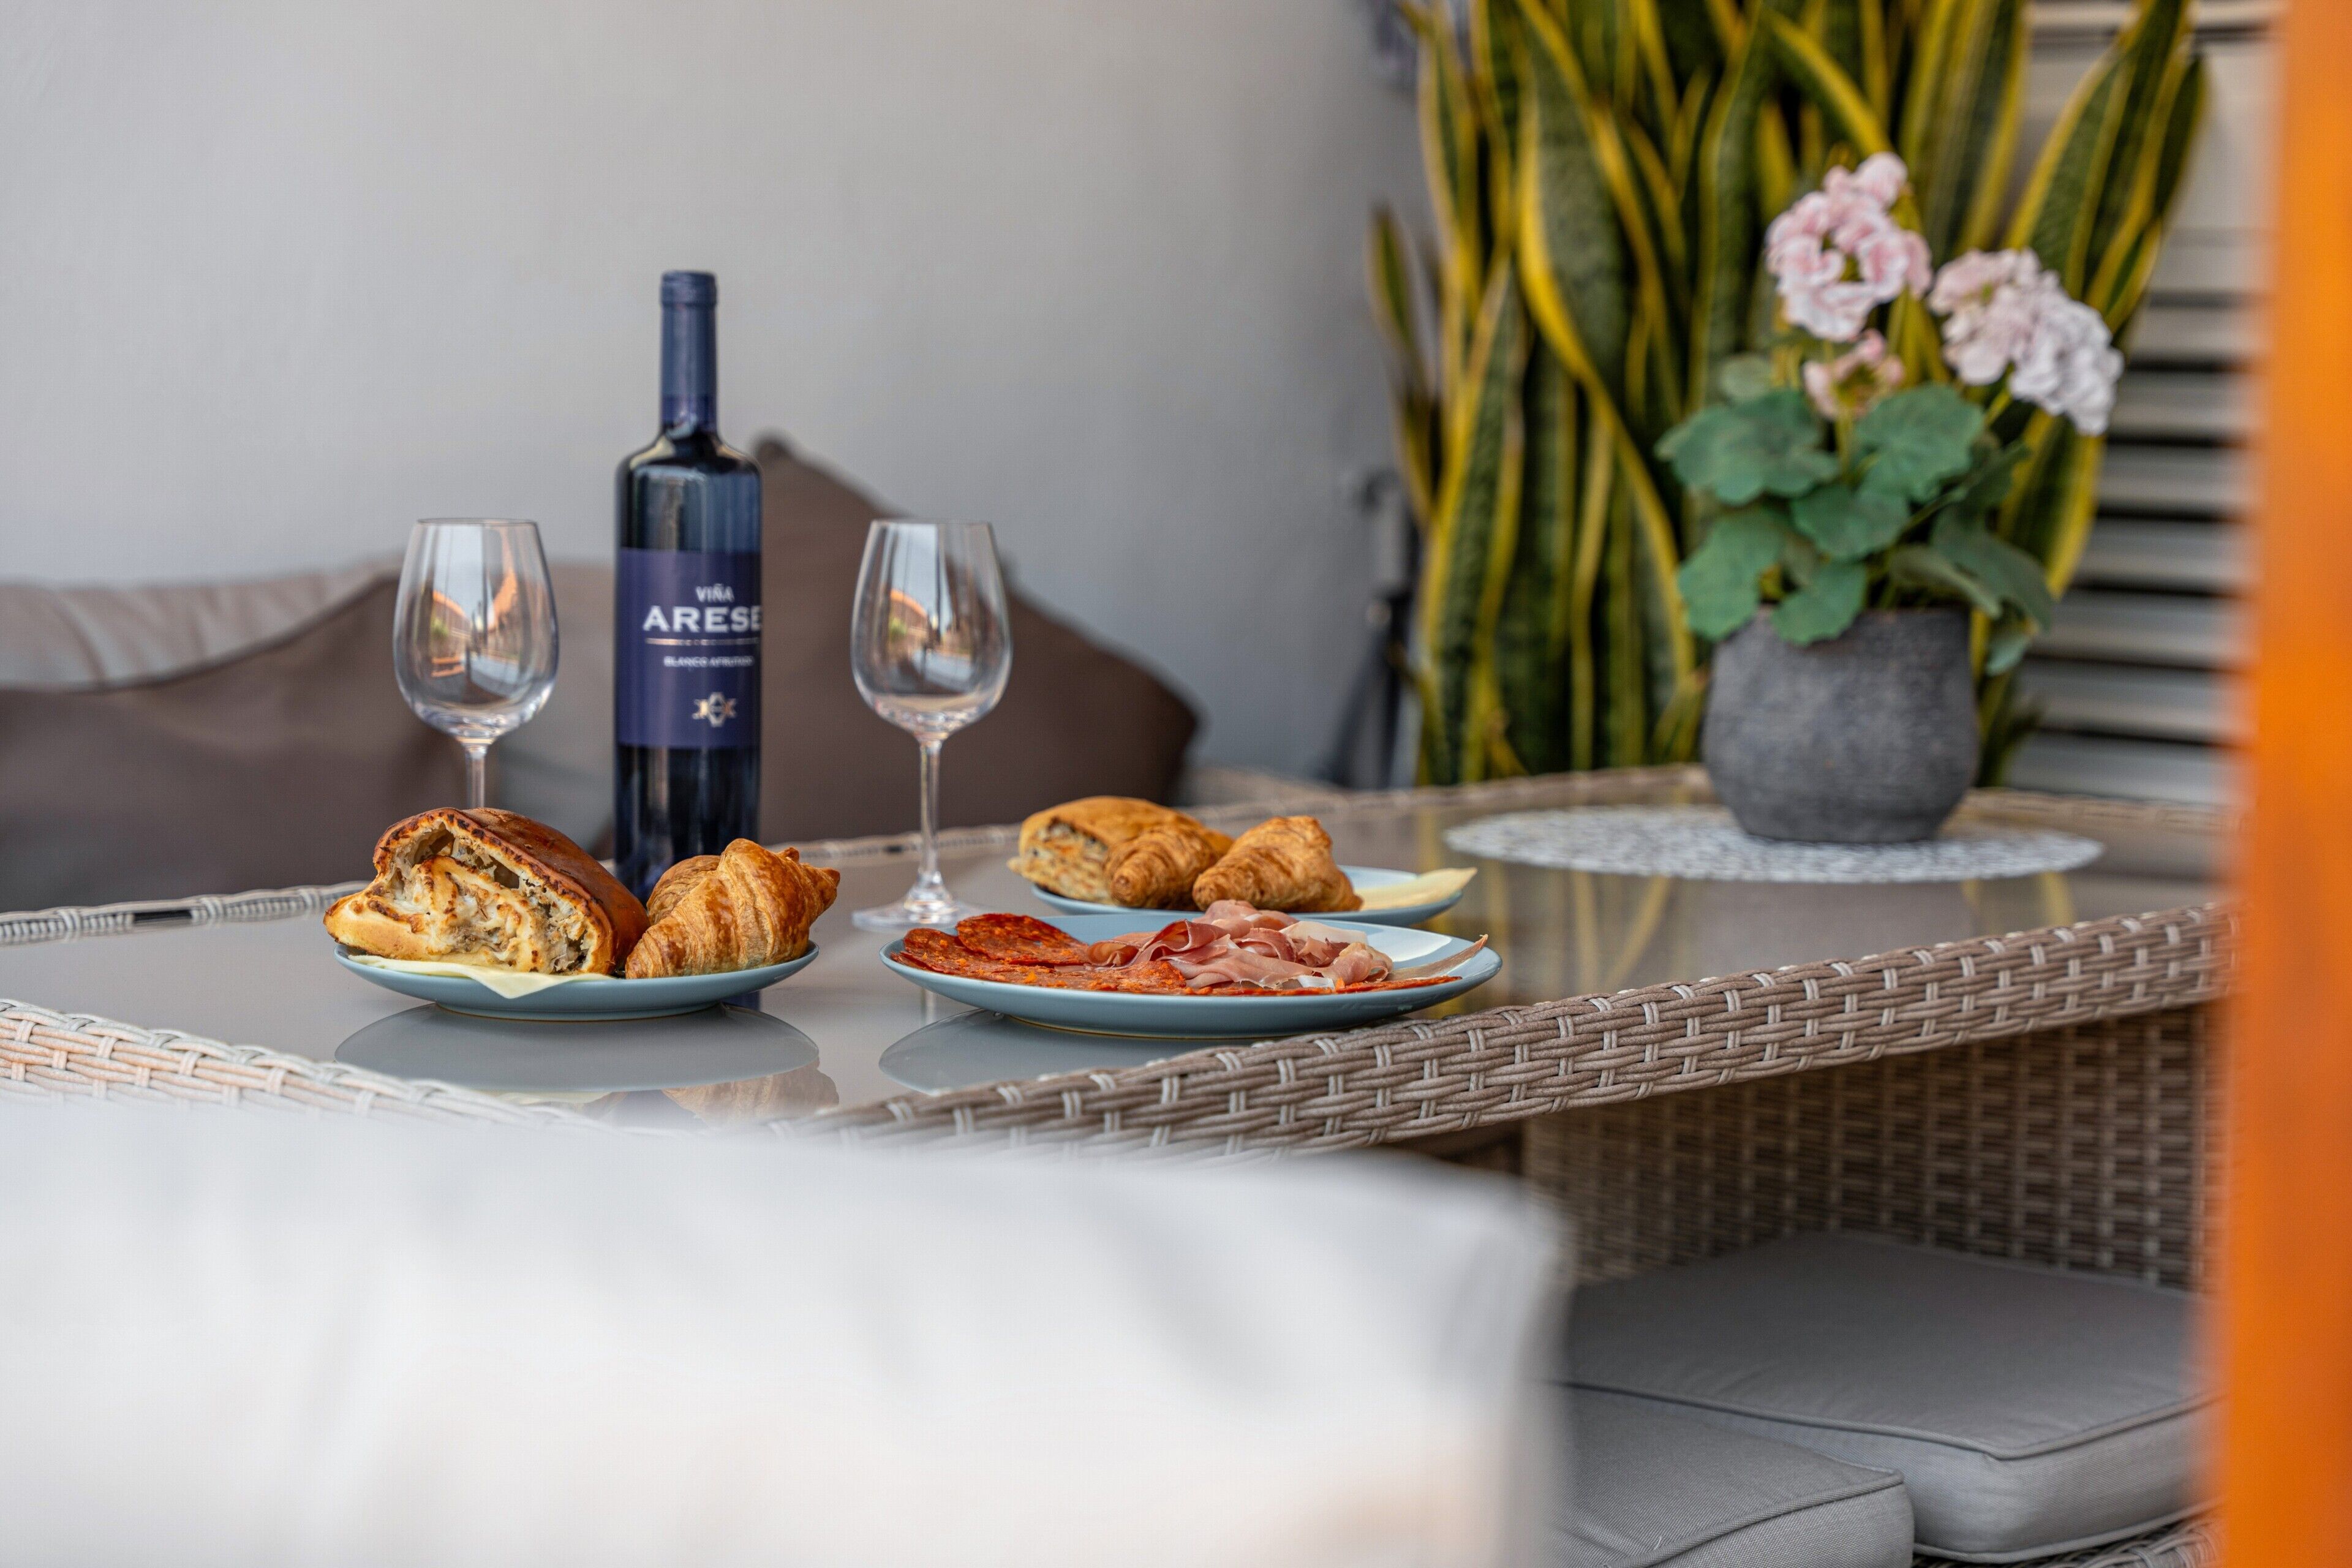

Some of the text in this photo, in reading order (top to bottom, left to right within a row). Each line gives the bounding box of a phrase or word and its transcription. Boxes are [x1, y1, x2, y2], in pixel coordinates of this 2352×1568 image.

[695, 583, 735, 603] VIÑA
[643, 605, 762, 633] ARESE
[663, 656, 708, 668] BLANCO
